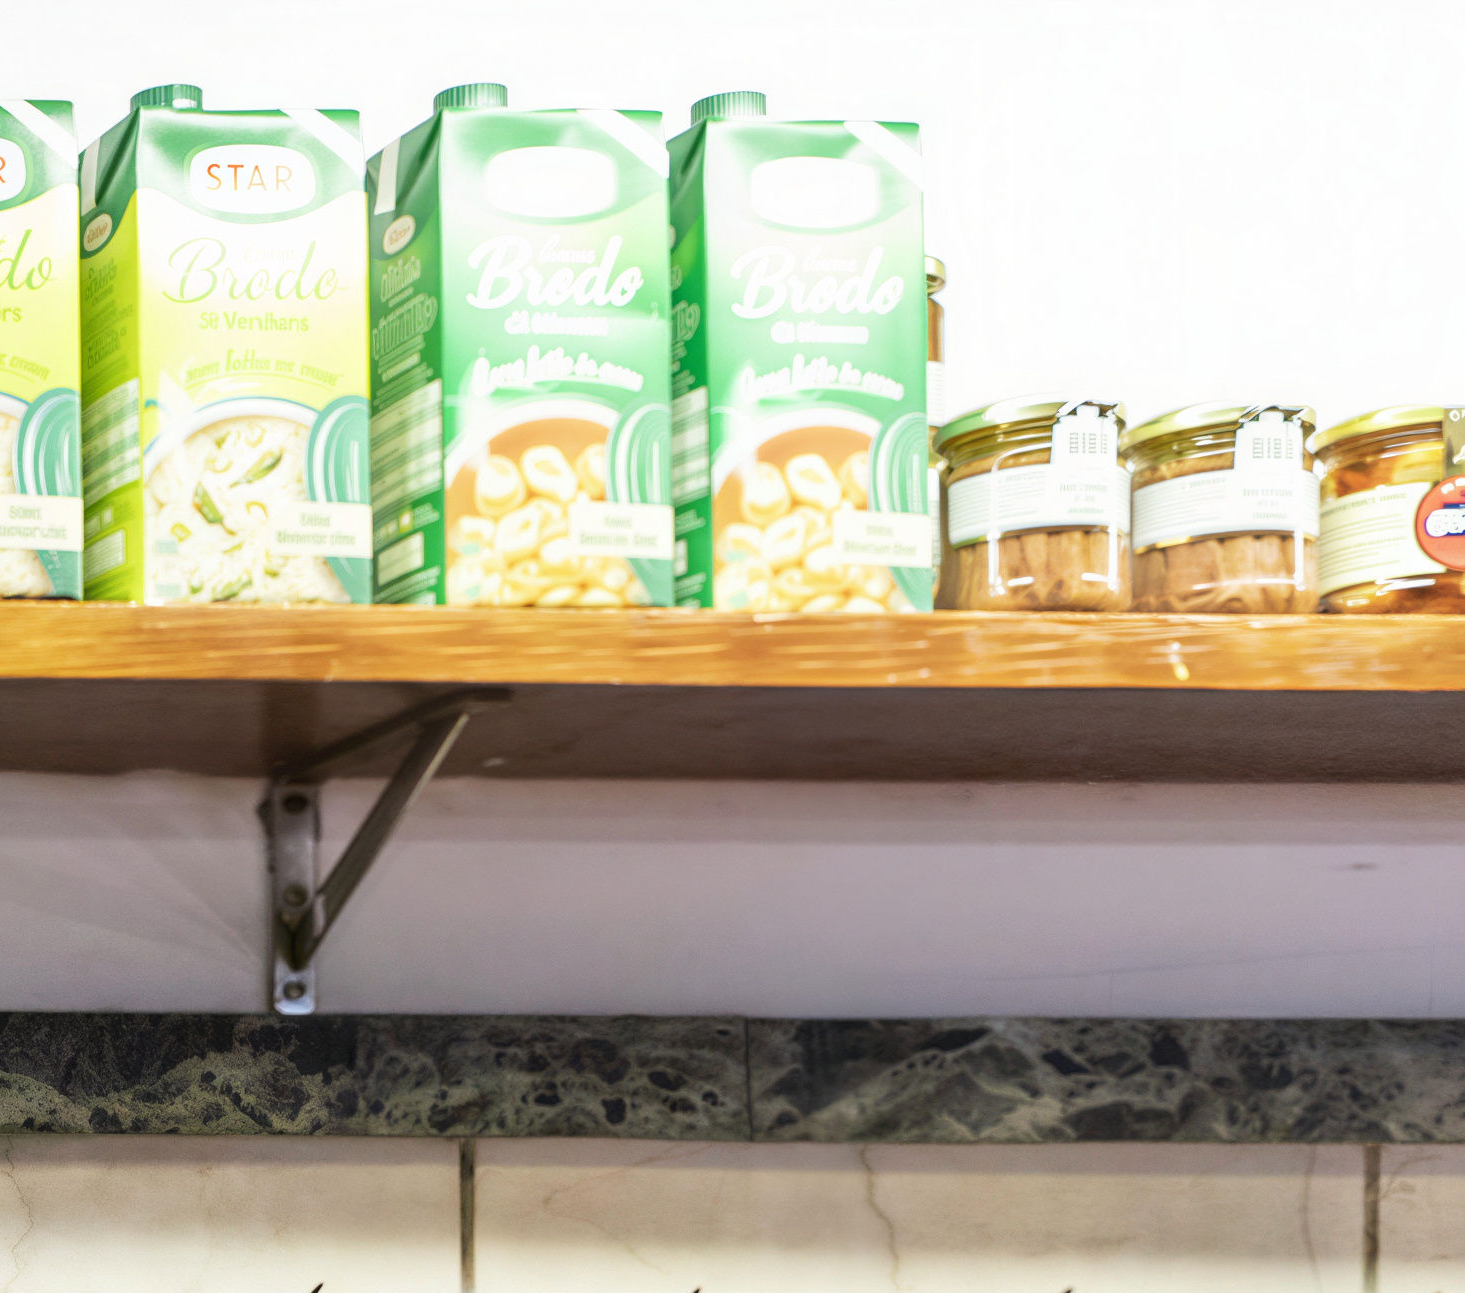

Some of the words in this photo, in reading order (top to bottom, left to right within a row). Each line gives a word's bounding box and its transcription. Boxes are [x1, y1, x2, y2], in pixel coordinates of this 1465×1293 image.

[207, 163, 292, 192] STAR
[162, 236, 344, 304] Brodo
[465, 234, 645, 310] Brodo
[730, 245, 905, 320] Brodo
